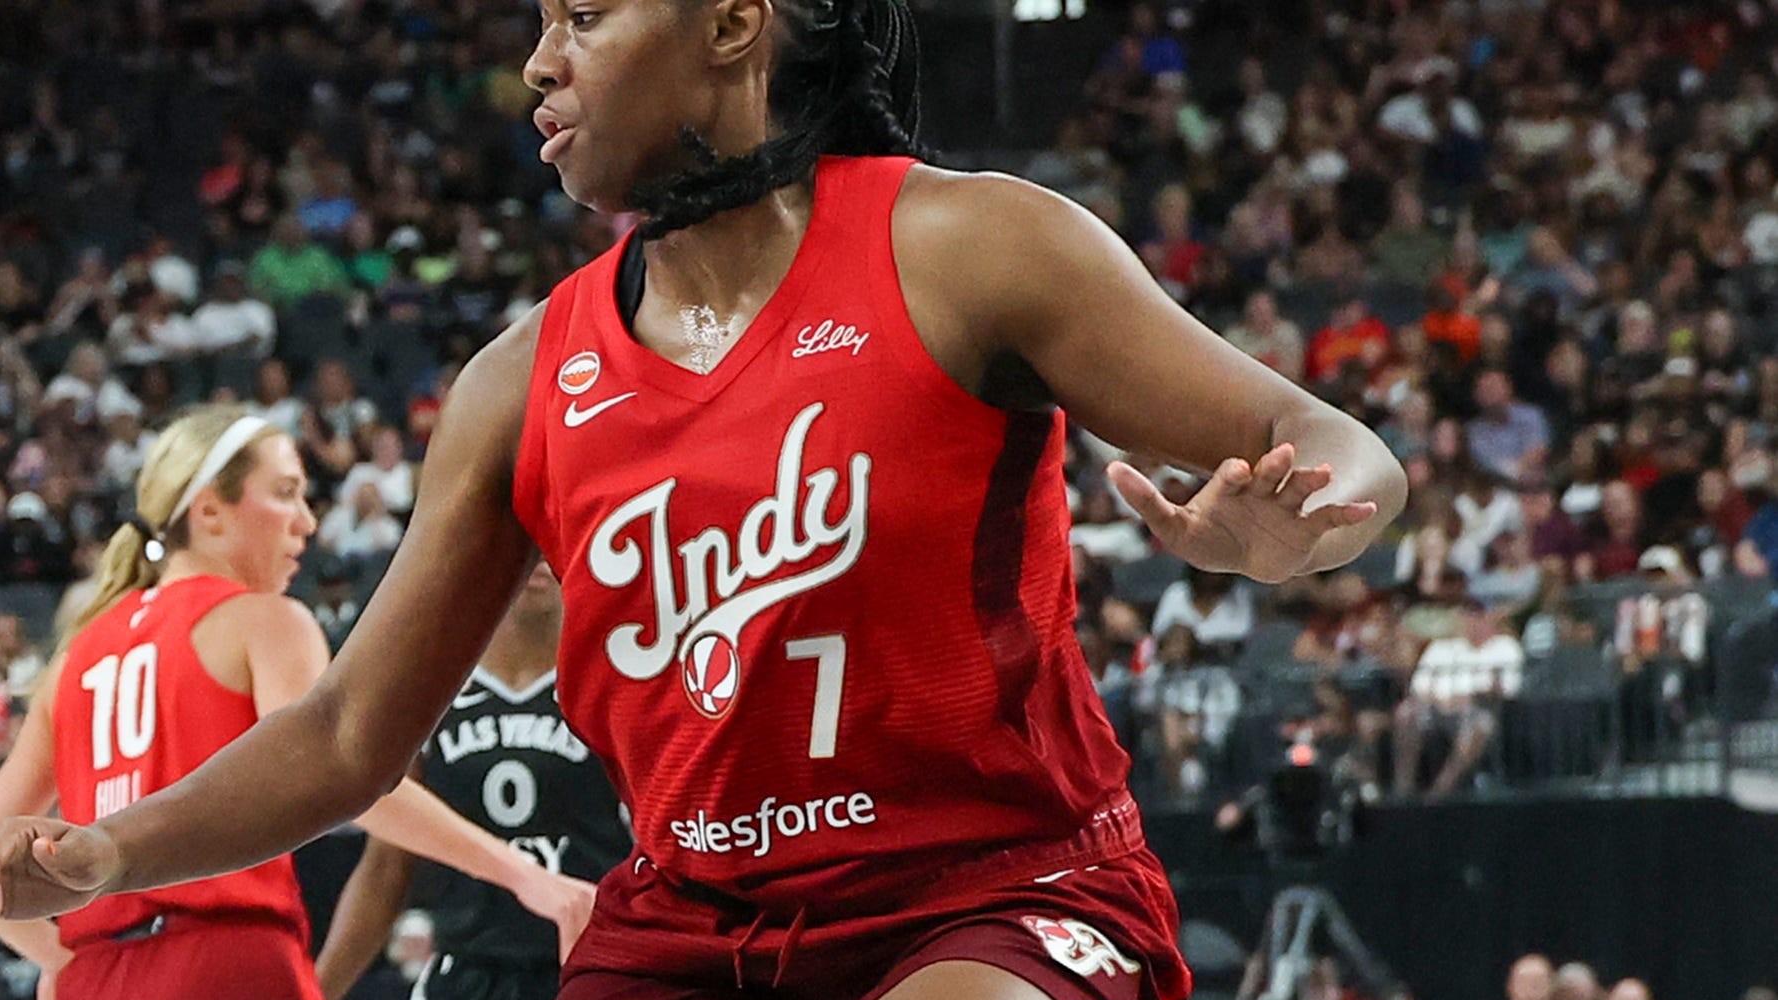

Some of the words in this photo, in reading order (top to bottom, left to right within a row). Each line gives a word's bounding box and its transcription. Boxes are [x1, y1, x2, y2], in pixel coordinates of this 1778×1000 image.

[792, 319, 870, 358] Lilly
[588, 401, 873, 681] Indy
[80, 641, 158, 771] 10
[785, 633, 846, 759] 7
[437, 714, 499, 764] LAS
[482, 759, 538, 828] 0
[670, 791, 876, 857] salesforce
[509, 835, 570, 875] SY
